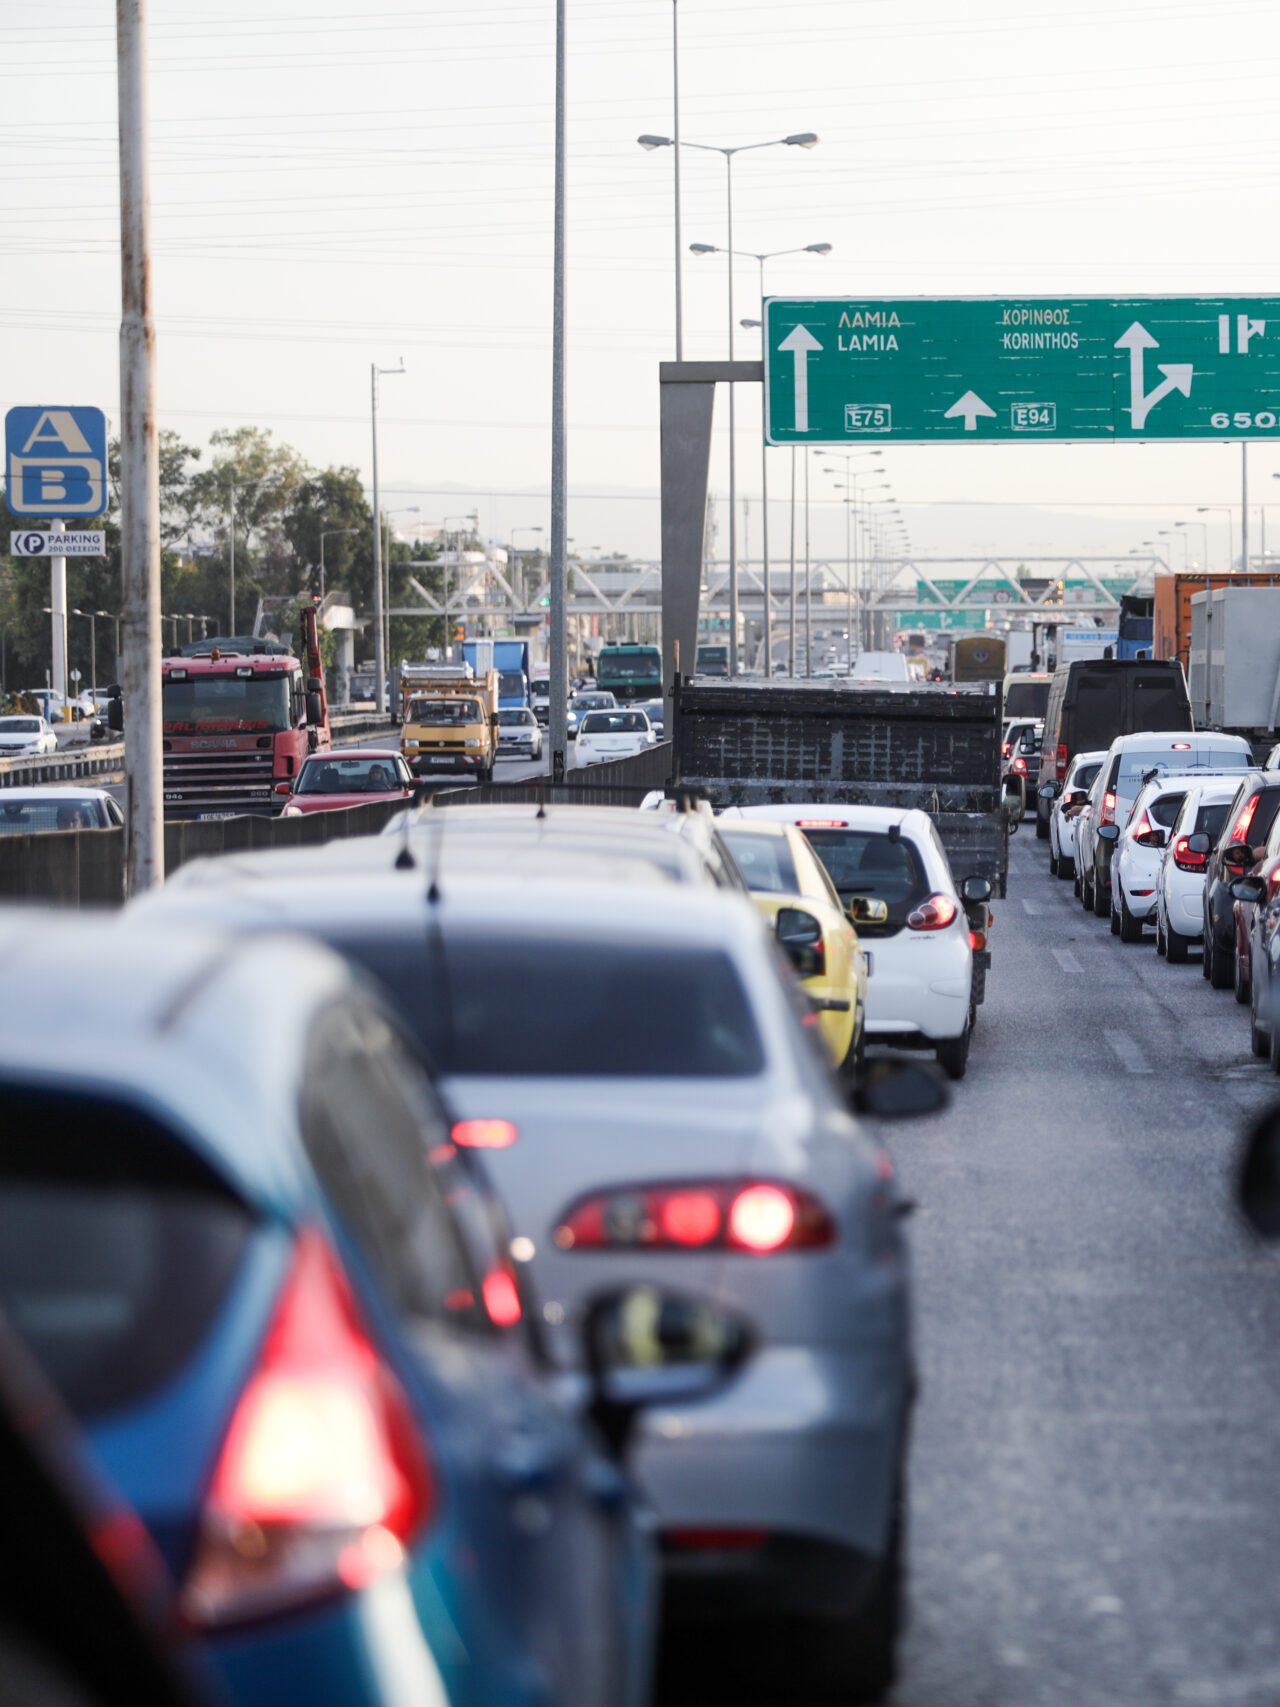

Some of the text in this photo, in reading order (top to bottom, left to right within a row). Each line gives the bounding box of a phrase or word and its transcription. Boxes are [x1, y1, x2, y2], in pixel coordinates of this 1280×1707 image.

[838, 311, 900, 328] ΛΑΜΙΑ
[1003, 309, 1070, 326] ΚΟΡΙΝΘΟΣ
[837, 334, 899, 351] LAMIA
[1003, 332, 1079, 350] KORINTHOS
[851, 409, 884, 426] E75
[1017, 408, 1050, 425] E94
[48, 535, 101, 544] PARKING
[191, 739, 237, 749] SCANIA
